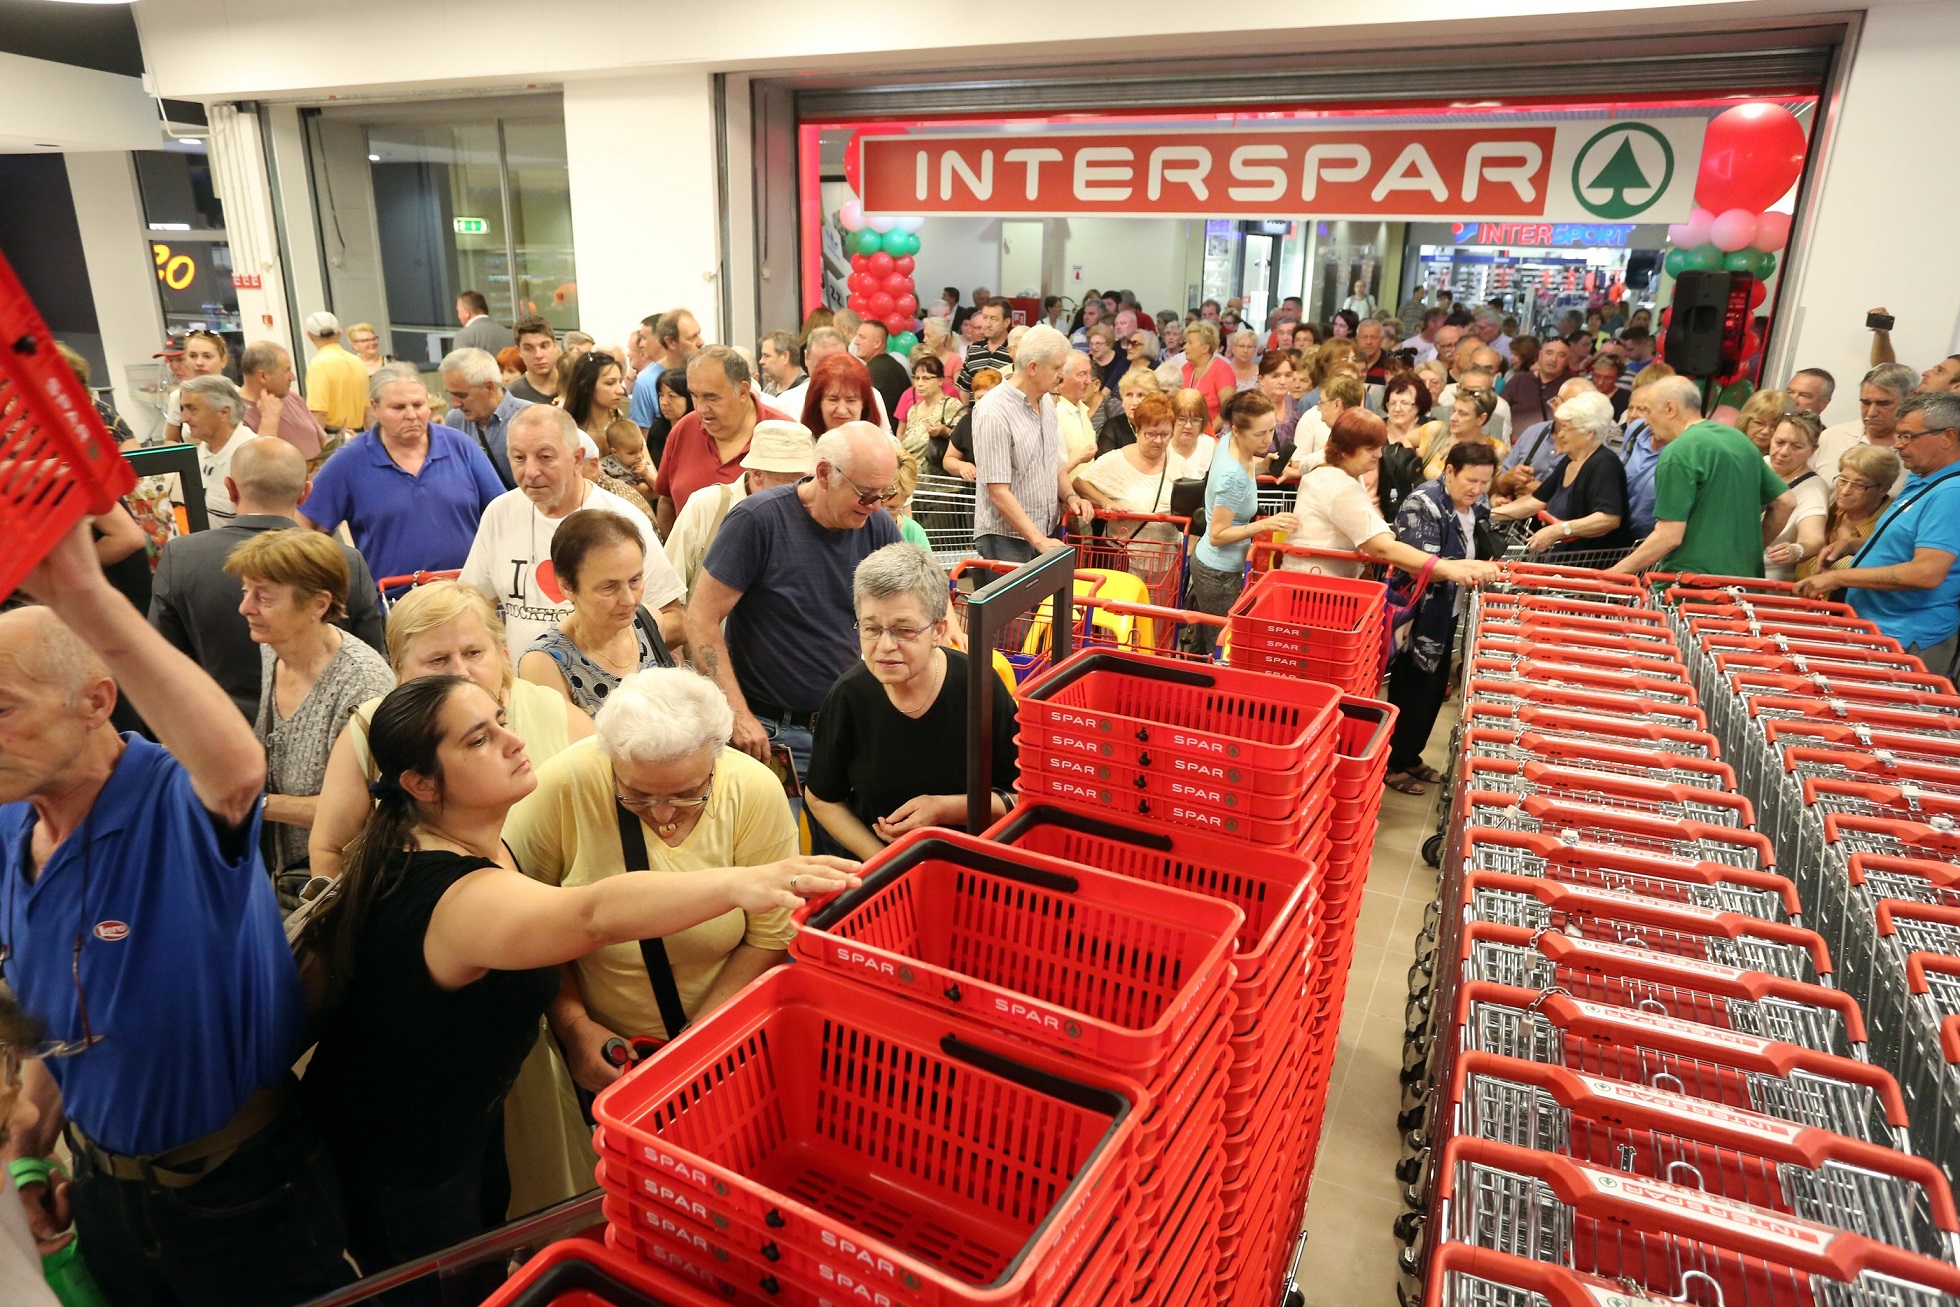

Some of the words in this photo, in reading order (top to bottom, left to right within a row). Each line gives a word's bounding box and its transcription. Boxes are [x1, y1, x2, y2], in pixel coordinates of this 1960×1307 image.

[916, 142, 1544, 203] INTERSPAR
[1478, 223, 1632, 246] INTERSPORT
[508, 559, 528, 600] I
[1267, 625, 1299, 636] SPAR
[1266, 640, 1299, 651] SPAR
[1265, 655, 1297, 667] SPAR
[1051, 711, 1096, 728] SPAR
[1052, 735, 1097, 752] SPAR
[1173, 734, 1223, 753] SPAR
[1050, 758, 1095, 775] SPAR
[1174, 759, 1224, 778] SPAR
[1052, 781, 1097, 798] SPAR
[1172, 783, 1221, 802] SPAR
[1173, 807, 1221, 826] SPAR
[837, 948, 894, 976] SPAR
[995, 998, 1059, 1030] SPAR
[1617, 1087, 1772, 1131] INTERSPAR
[643, 1146, 707, 1186] SPAR
[644, 1179, 707, 1219] SPAR
[1625, 1182, 1800, 1239] INTERSPAR
[646, 1211, 707, 1251] SPAR
[653, 1244, 714, 1285] SPAR
[821, 1229, 894, 1277] SPAR
[818, 1263, 891, 1307] SPAR
